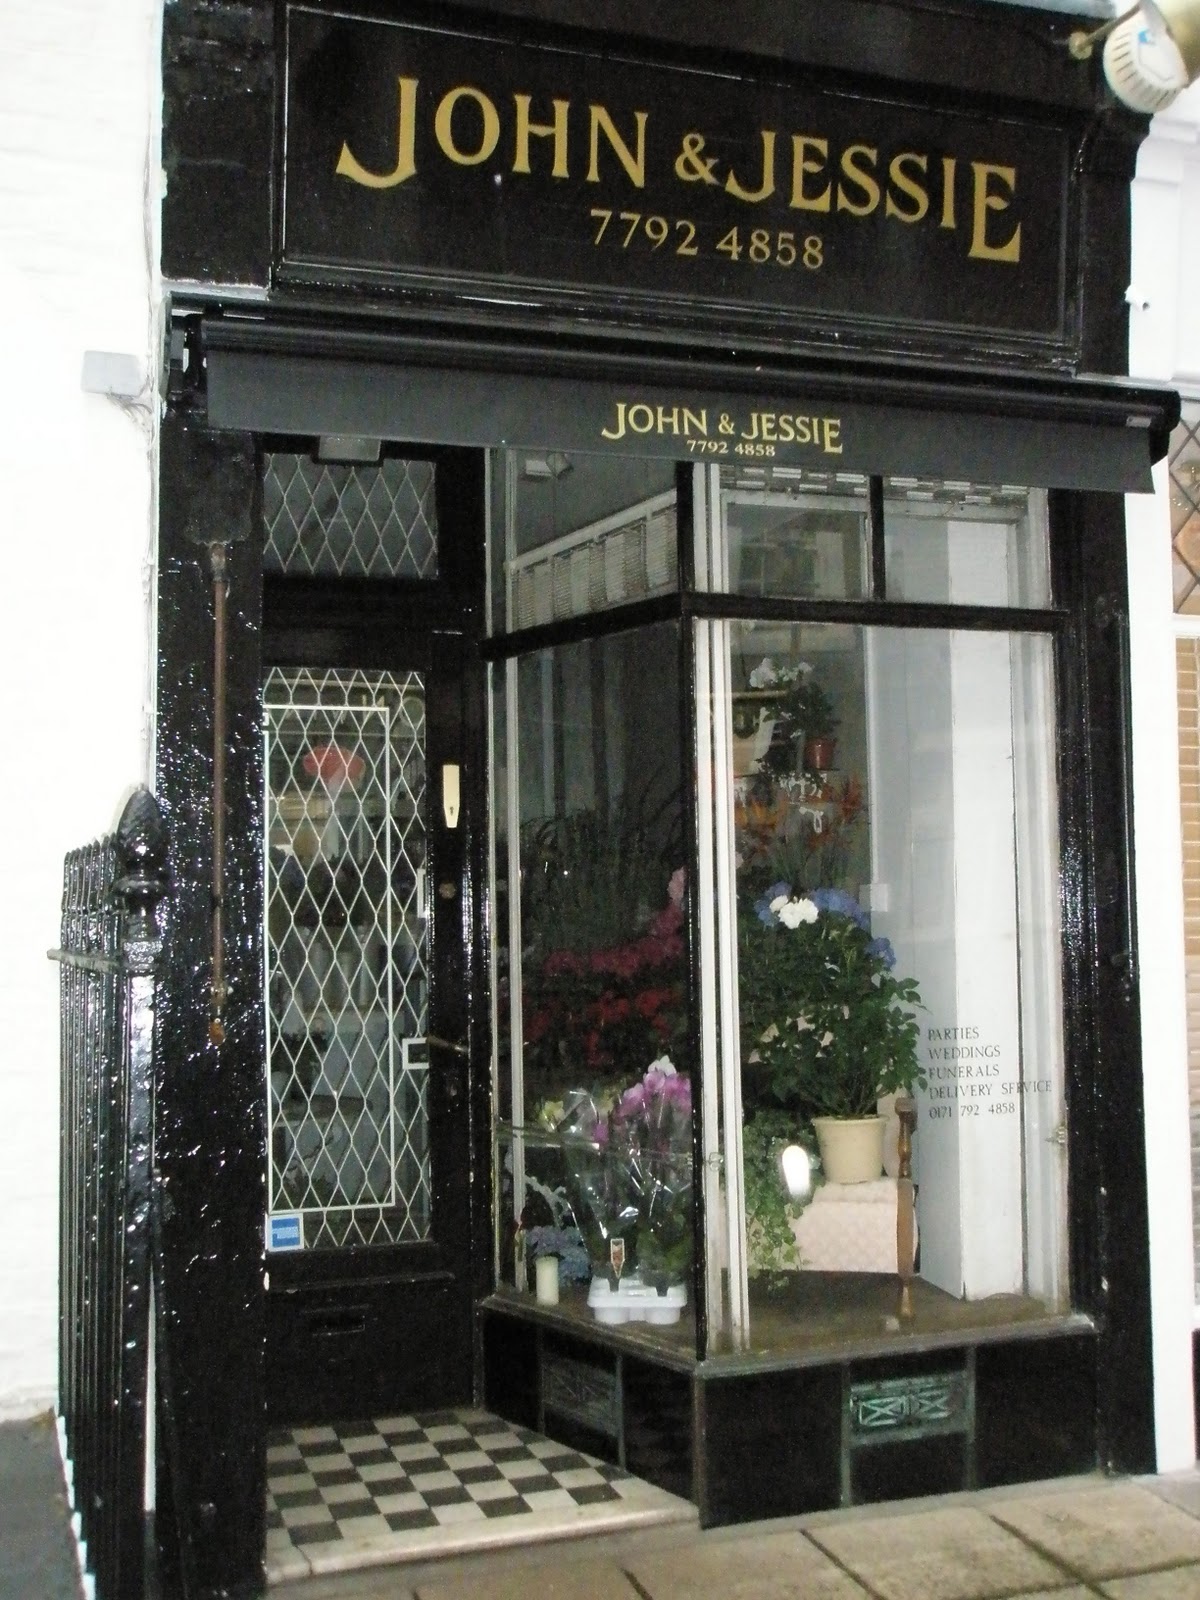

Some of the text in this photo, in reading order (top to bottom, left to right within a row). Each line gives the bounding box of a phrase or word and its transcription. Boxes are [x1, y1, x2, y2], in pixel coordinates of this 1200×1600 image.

[336, 74, 1023, 264] JOHN & JESSIE
[590, 208, 825, 269] 7792 4858
[601, 402, 843, 454] JOHN & JESSIE
[686, 439, 776, 457] 7792 4858
[928, 1027, 980, 1041] PARTIES
[928, 1045, 1001, 1060] WEDDINGS
[928, 1064, 1000, 1080] FUNERALS
[929, 1083, 993, 1100] DELIVERY
[928, 1103, 1016, 1119] 0171 792 4858
